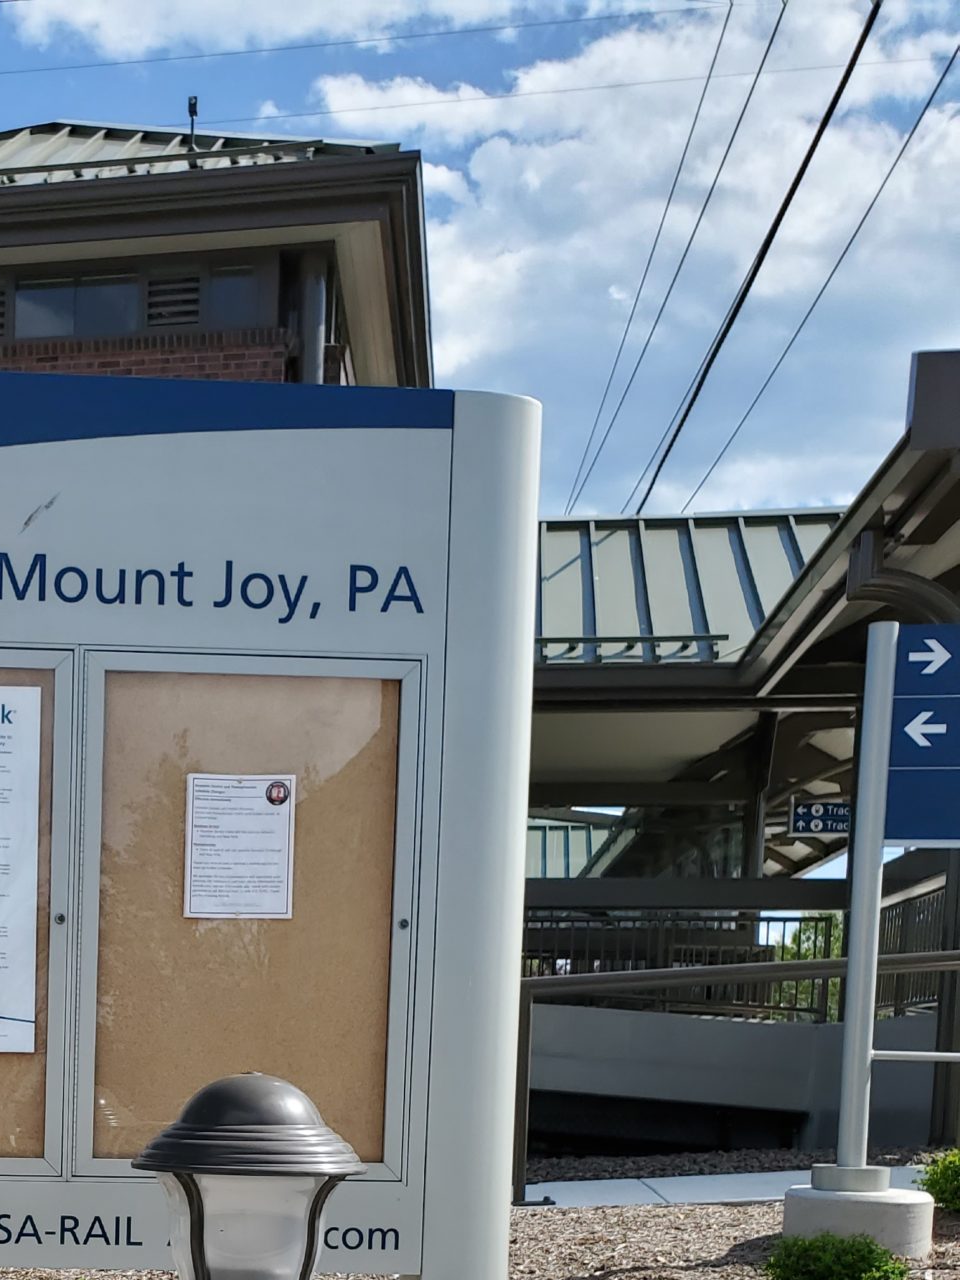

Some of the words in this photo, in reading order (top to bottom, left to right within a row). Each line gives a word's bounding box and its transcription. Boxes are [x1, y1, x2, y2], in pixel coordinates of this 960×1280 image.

[214, 561, 321, 624] Joy,
[349, 564, 424, 614] PA
[827, 806, 849, 815] Trac
[826, 820, 849, 830] Trac
[324, 1226, 400, 1250] com
